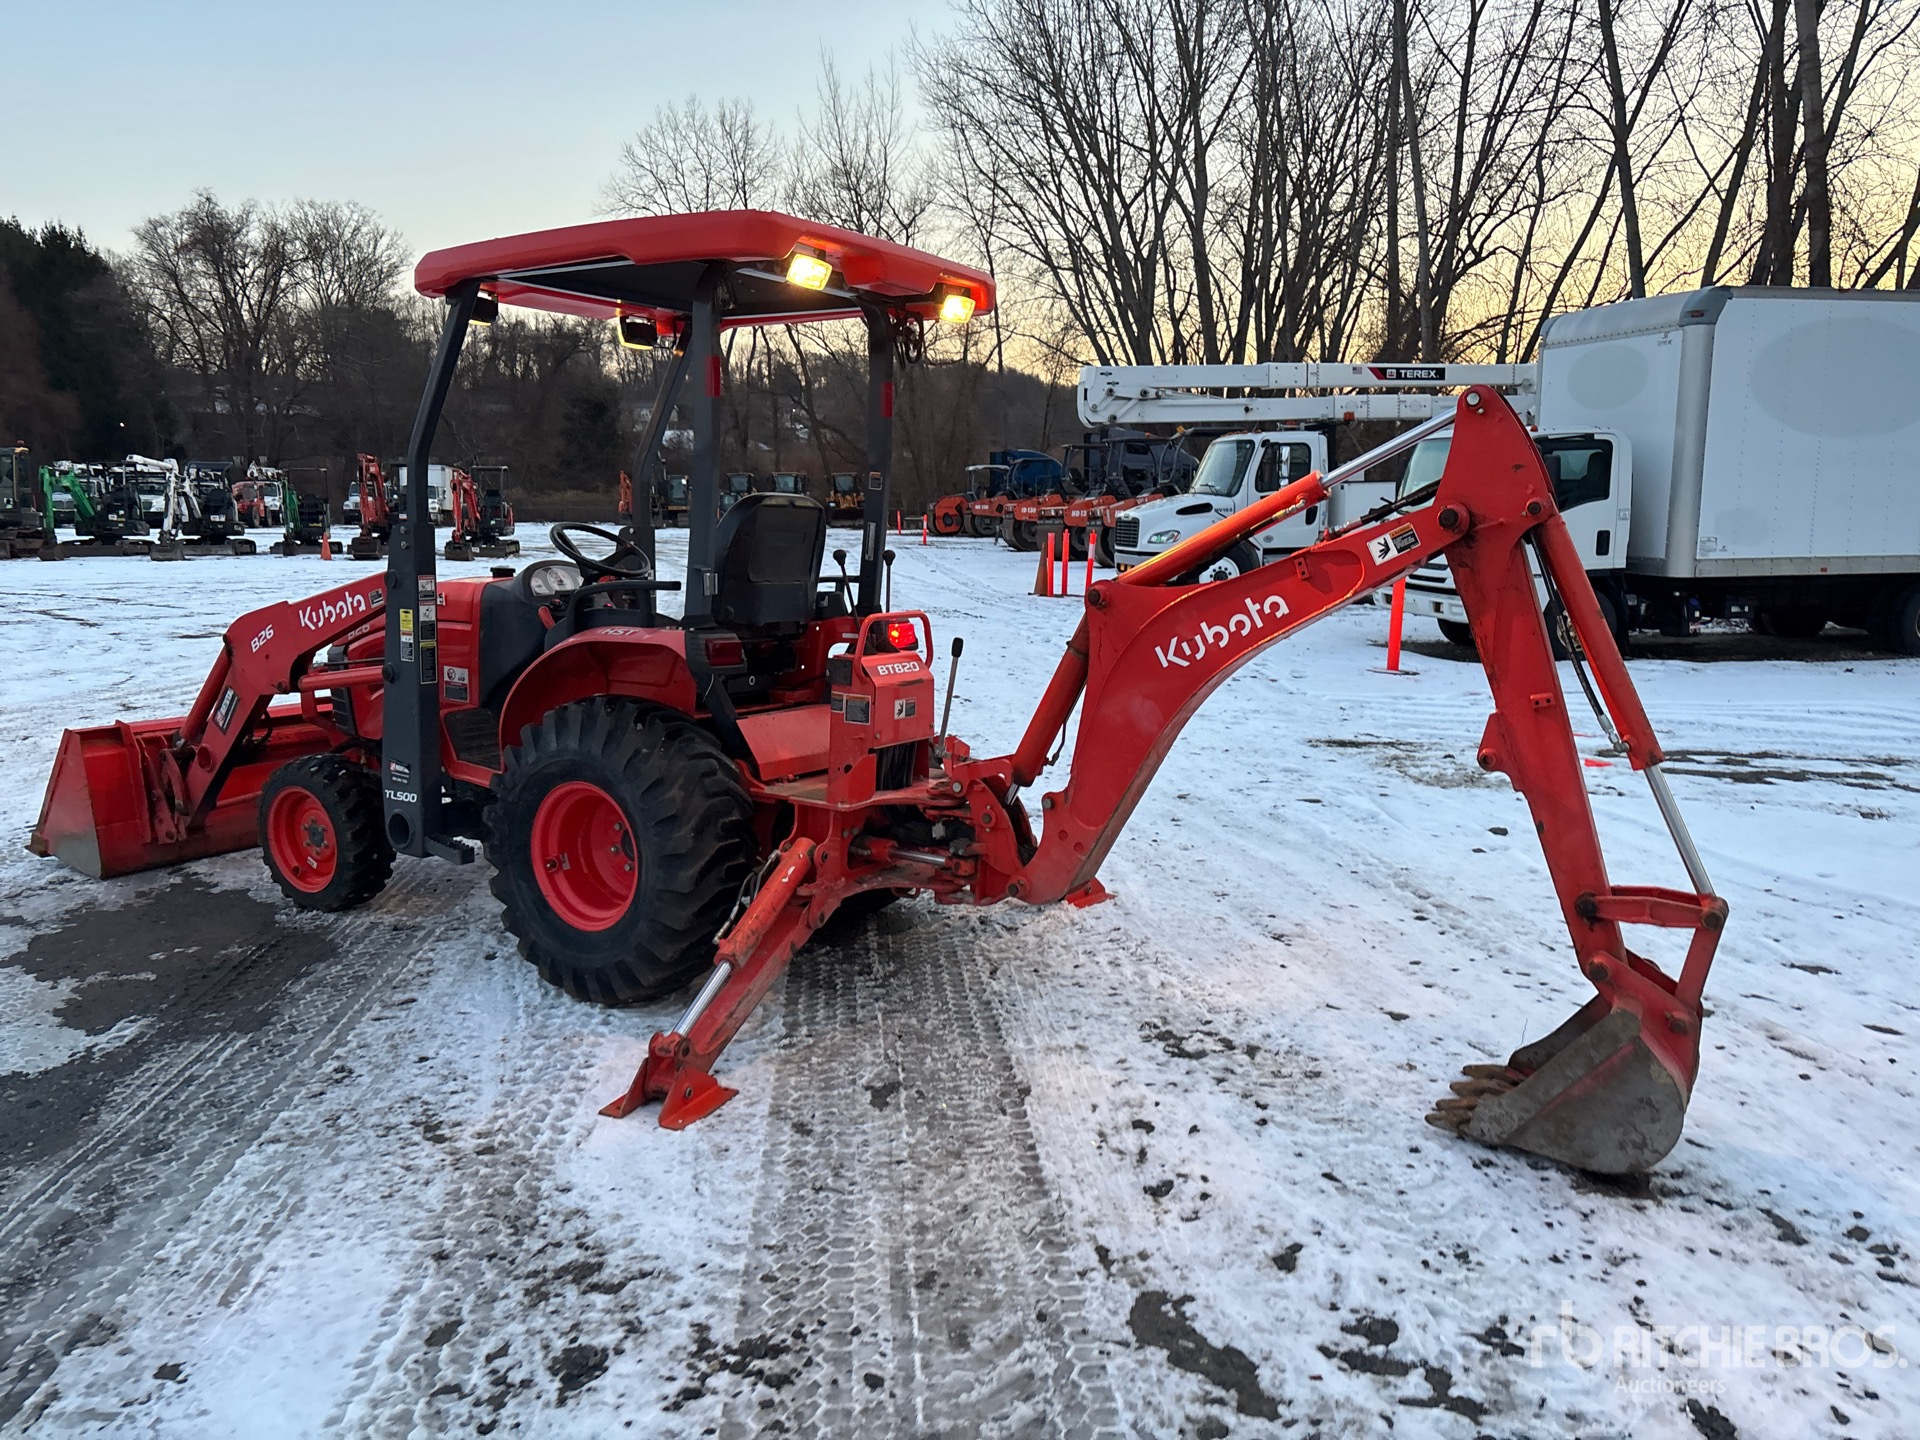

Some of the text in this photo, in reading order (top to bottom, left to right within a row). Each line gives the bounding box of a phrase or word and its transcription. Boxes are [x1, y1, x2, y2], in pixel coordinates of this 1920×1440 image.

[1399, 368, 1438, 379] TEREX
[298, 590, 367, 631] Kubota
[250, 623, 274, 653] B26
[601, 627, 639, 636] HST
[1154, 594, 1290, 668] Kubota
[877, 661, 920, 676] BT820
[384, 789, 417, 803] TL500
